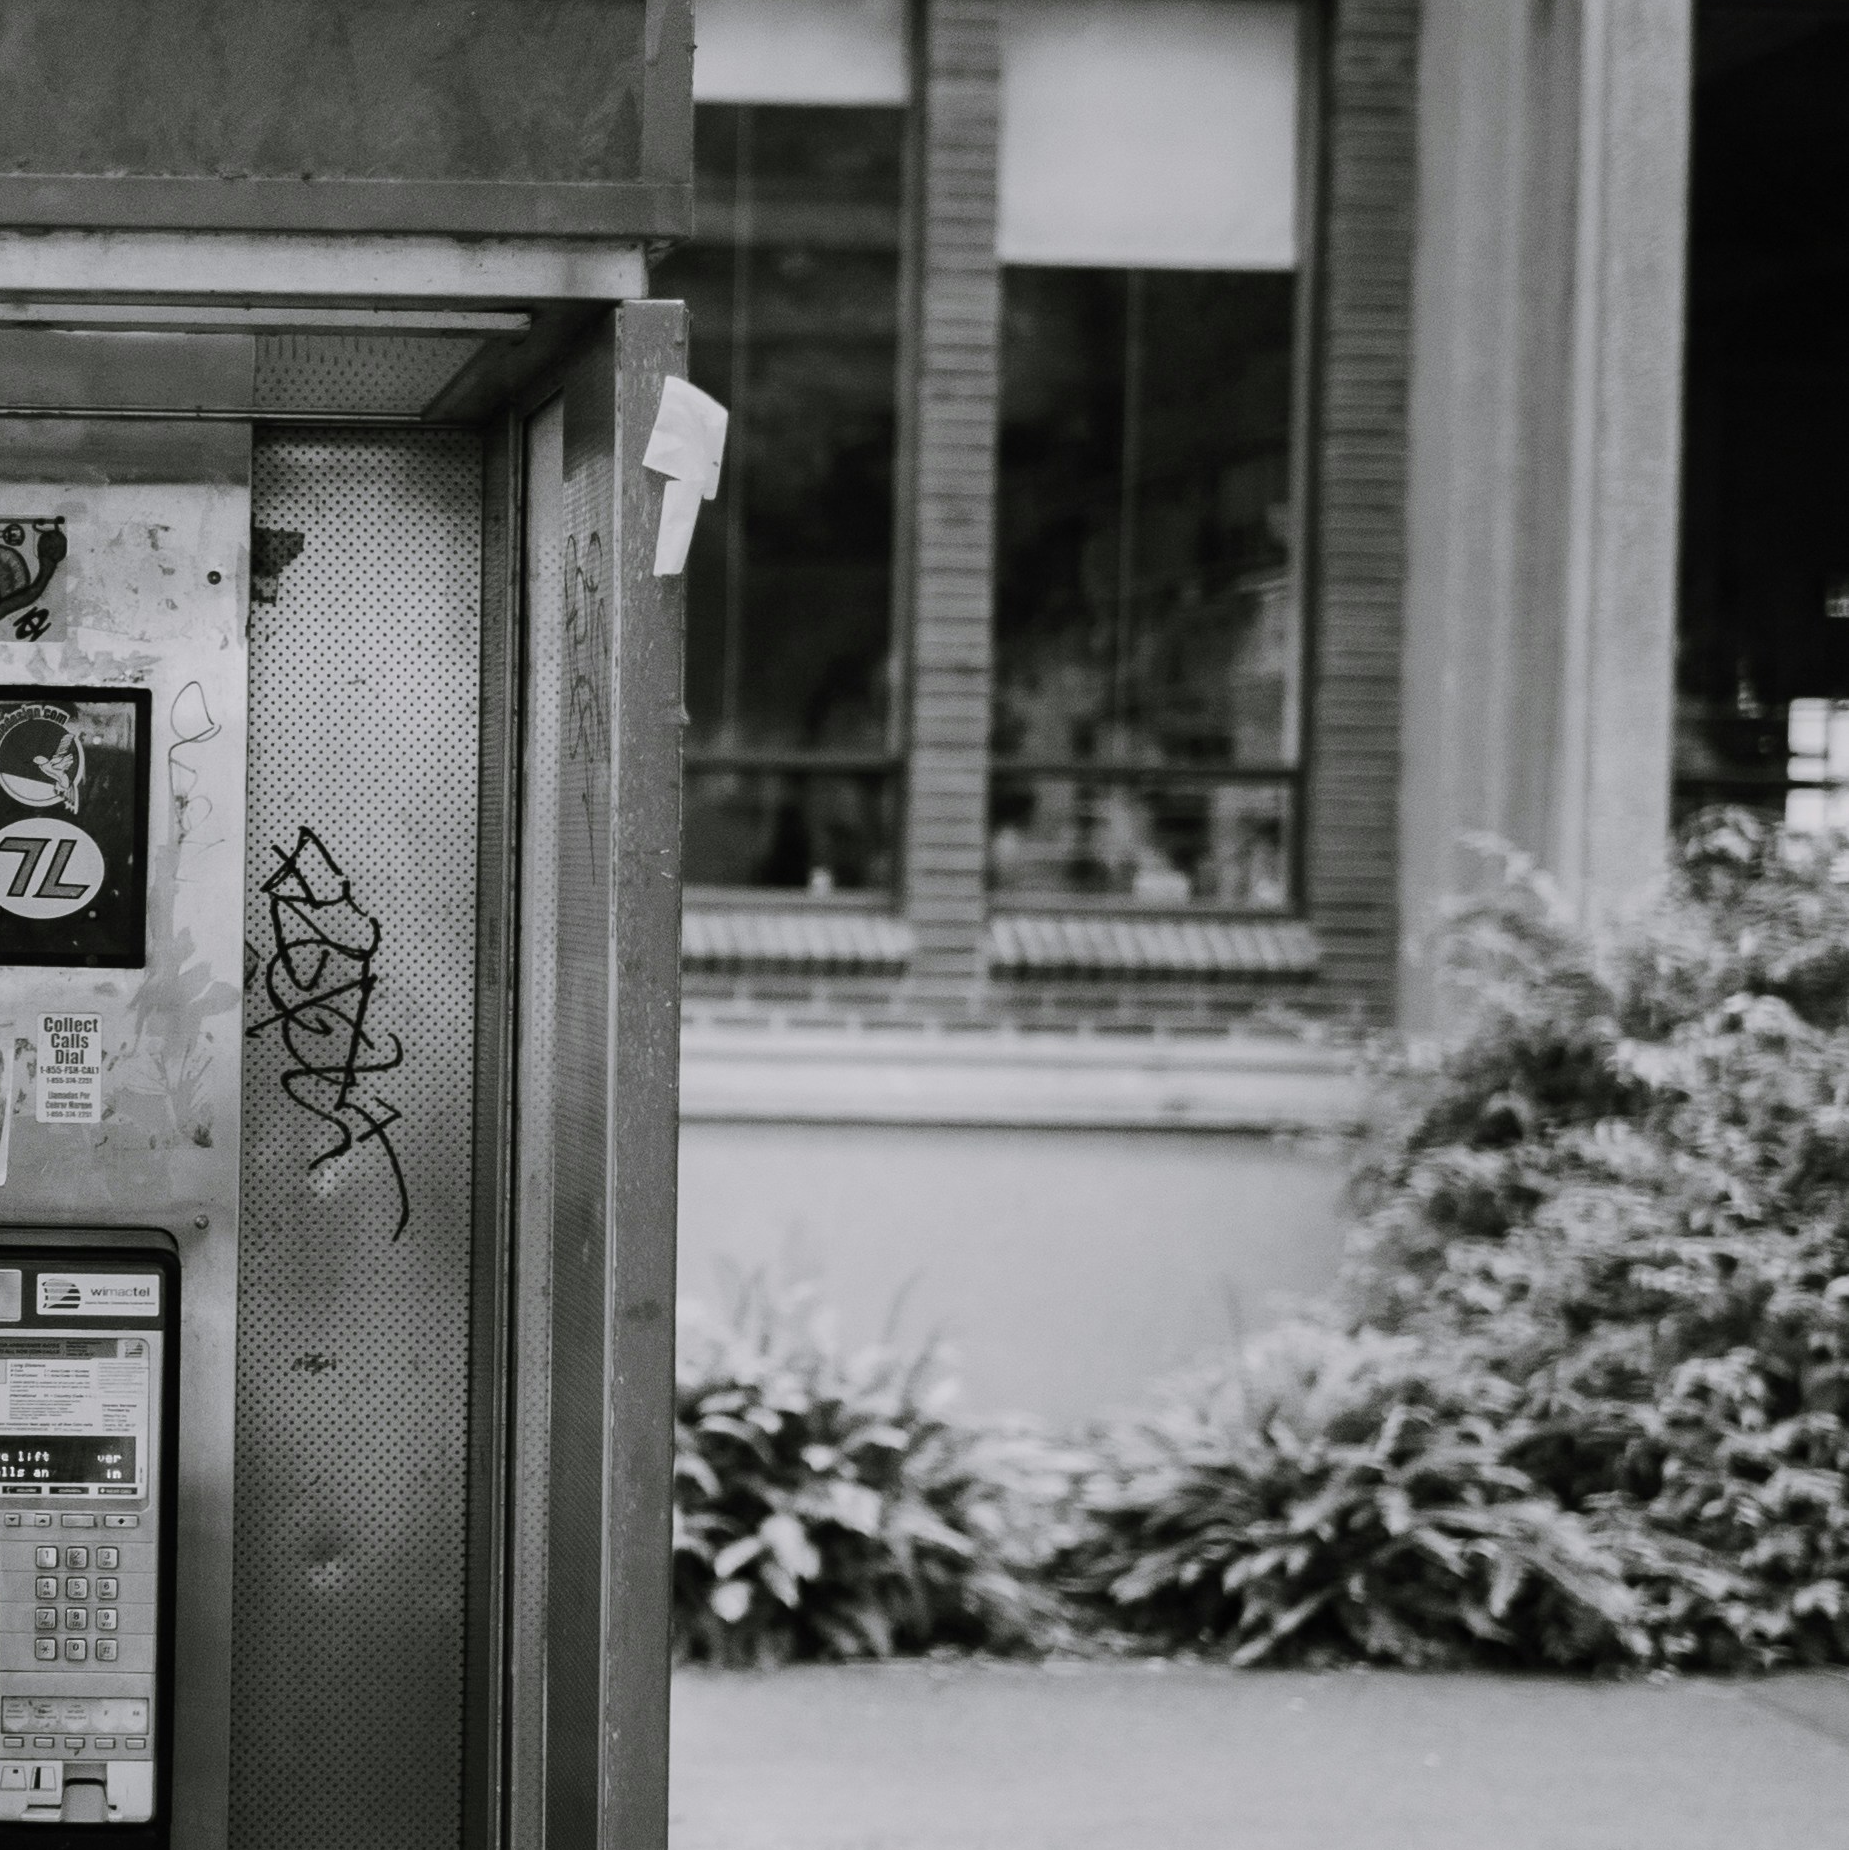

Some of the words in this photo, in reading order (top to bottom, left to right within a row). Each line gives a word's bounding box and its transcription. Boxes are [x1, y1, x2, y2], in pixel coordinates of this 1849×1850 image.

[44, 1017, 98, 1033] Collect
[51, 1033, 89, 1049] Calls
[55, 1049, 85, 1065] Dial
[91, 1286, 150, 1297] wimactel
[18, 1451, 50, 1462] lift
[104, 1551, 111, 1560] 3
[43, 1581, 49, 1589] 4
[74, 1581, 81, 1590] 5
[103, 1581, 110, 1590] 6
[43, 1612, 49, 1620] 7
[73, 1611, 80, 1620] 8
[104, 1611, 110, 1620] 9
[72, 1643, 80, 1651] 0
